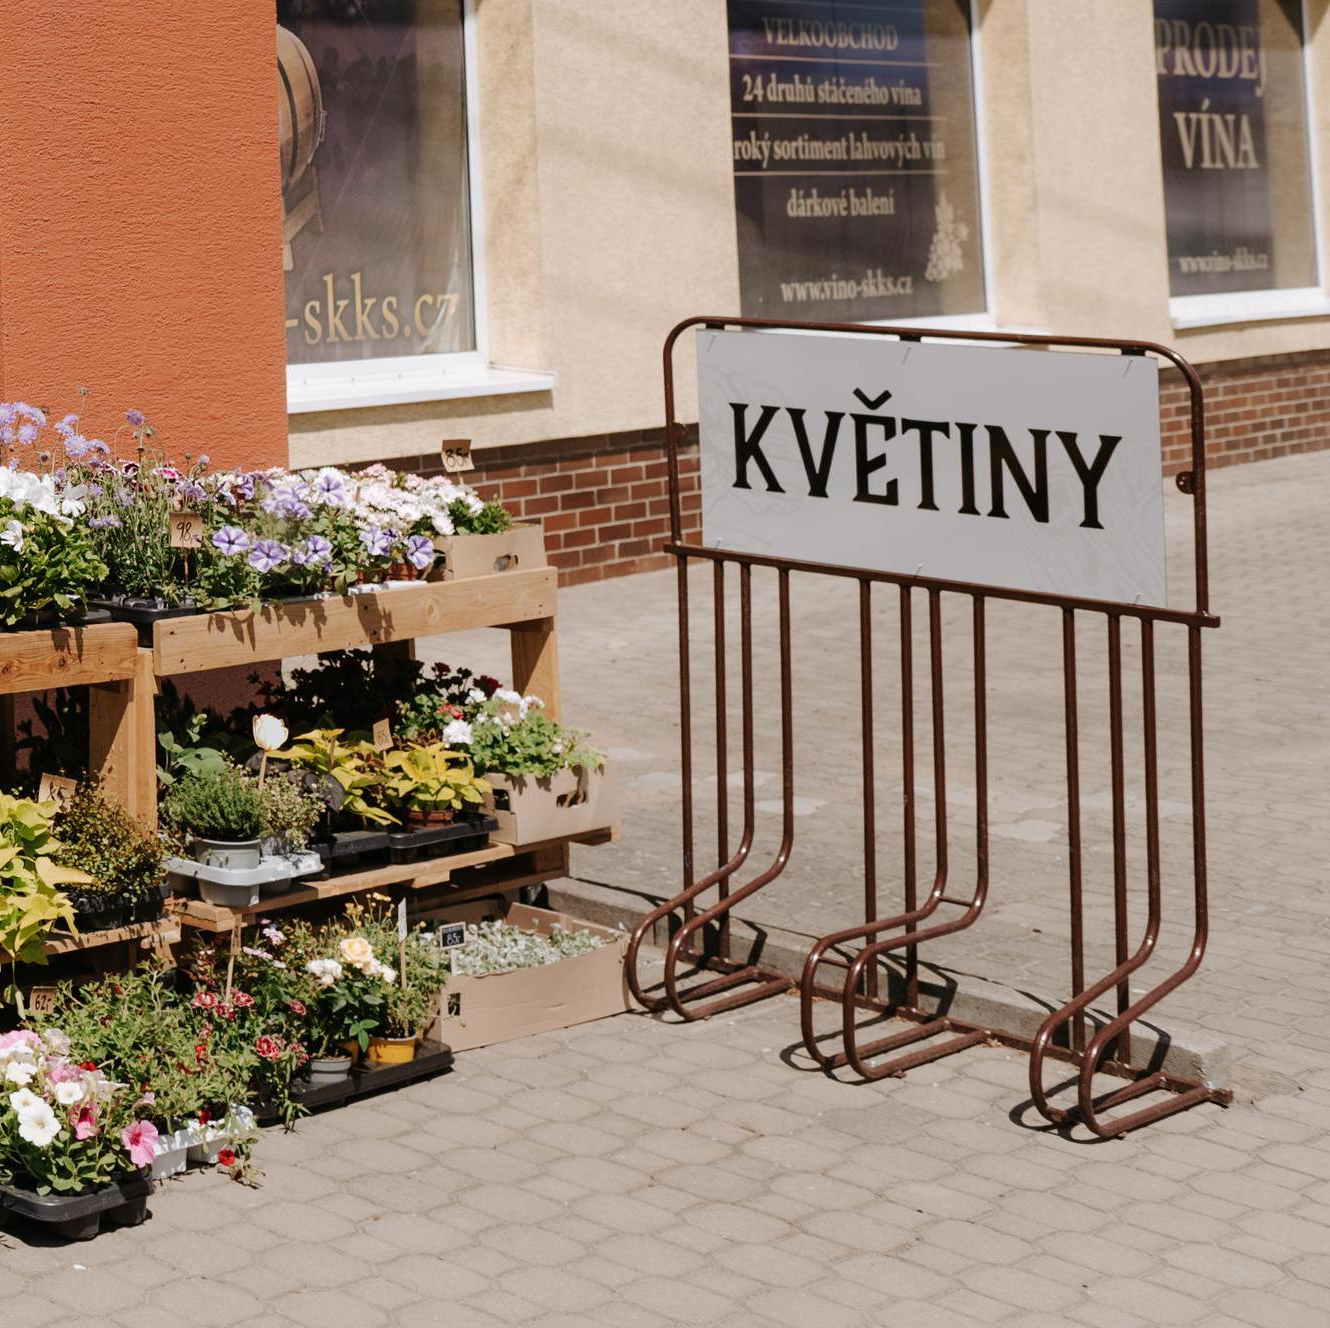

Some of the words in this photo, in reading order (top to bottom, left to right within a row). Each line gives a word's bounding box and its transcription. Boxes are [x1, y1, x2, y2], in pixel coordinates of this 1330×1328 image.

[762, 17, 899, 51] VELKOOBCHOD
[1155, 18, 1267, 97] PRODEJ
[743, 75, 764, 102] 24
[773, 133, 849, 161] sortiment
[1173, 97, 1259, 170] VÍNA
[786, 187, 847, 218] dárkové
[728, 387, 1123, 530] KVĚTINY
